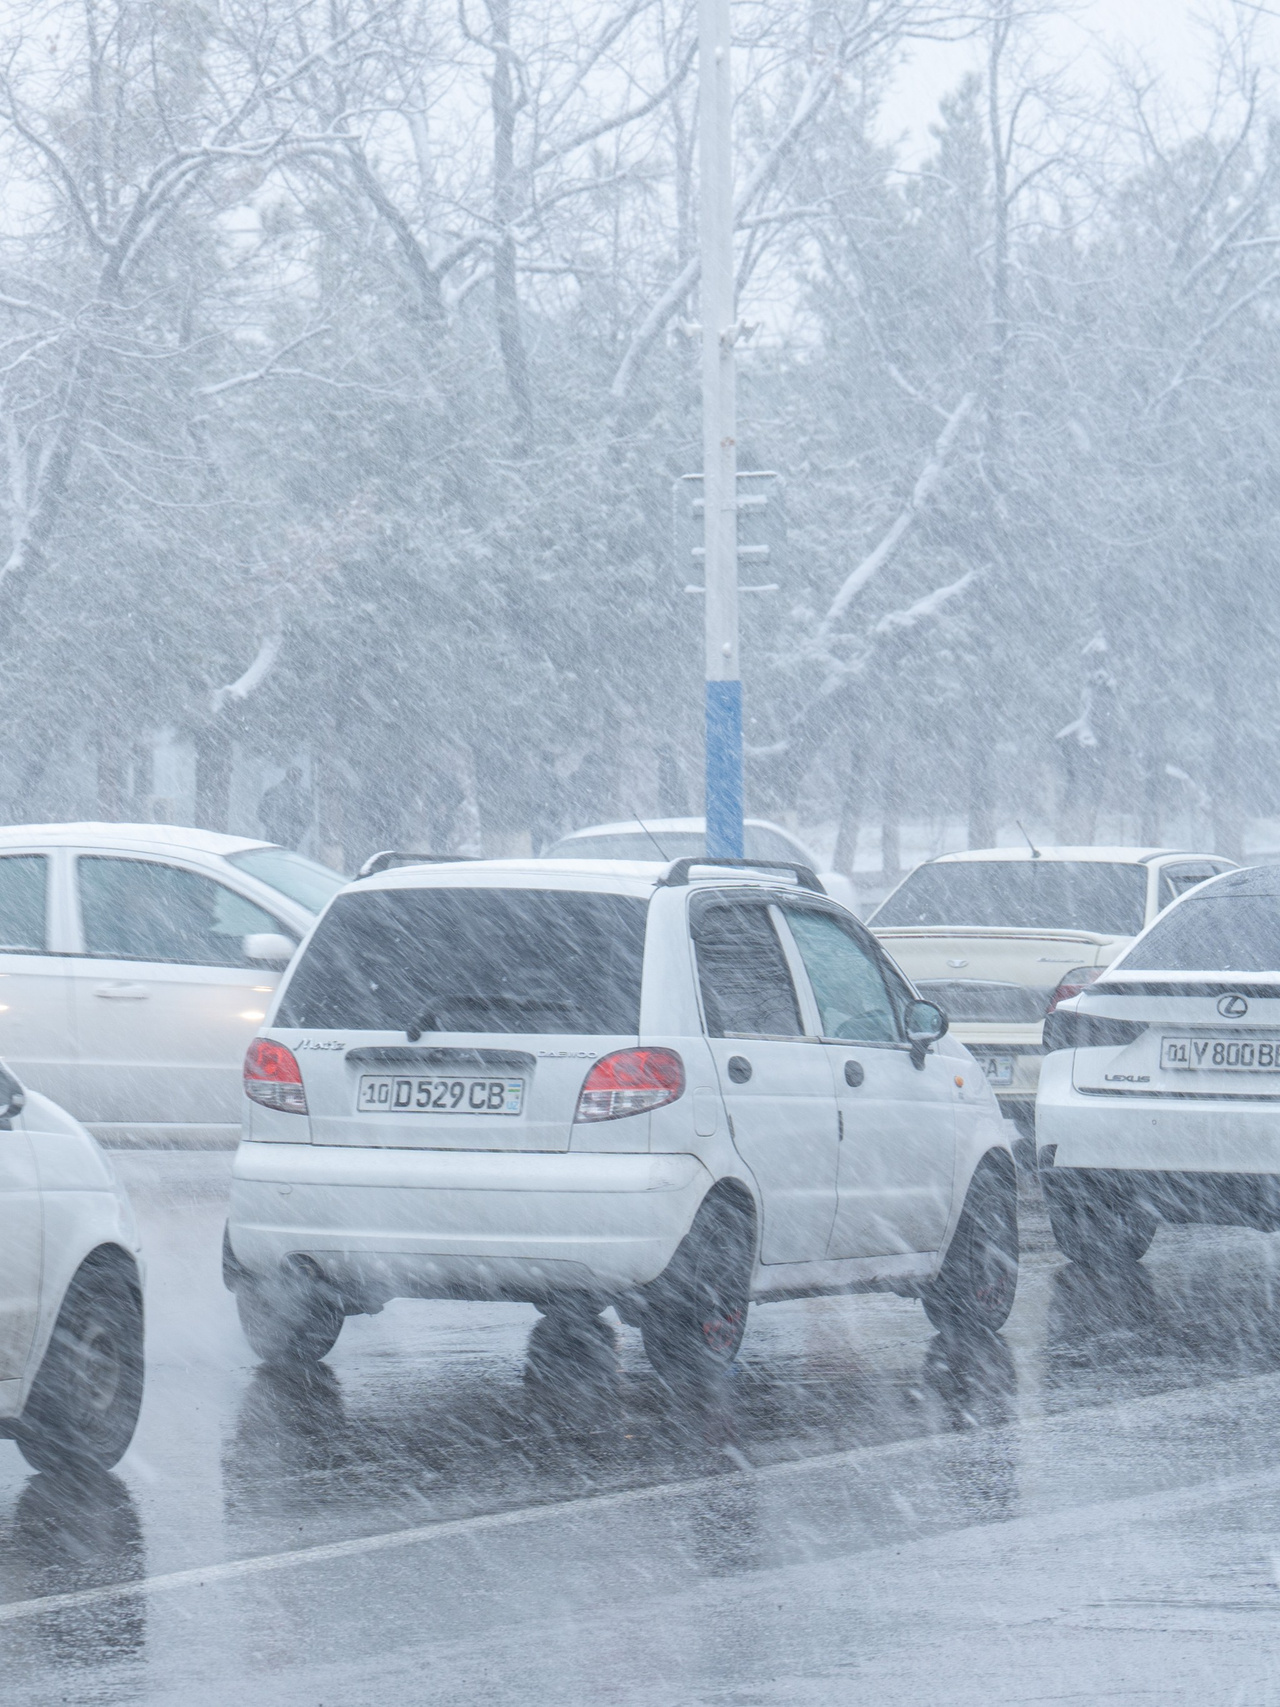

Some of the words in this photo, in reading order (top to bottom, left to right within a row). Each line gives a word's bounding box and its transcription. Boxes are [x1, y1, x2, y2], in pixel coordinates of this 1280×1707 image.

[537, 1051, 598, 1059] DAEWOO
[1105, 1074, 1150, 1083] LEXUS
[365, 1083, 389, 1104] 10
